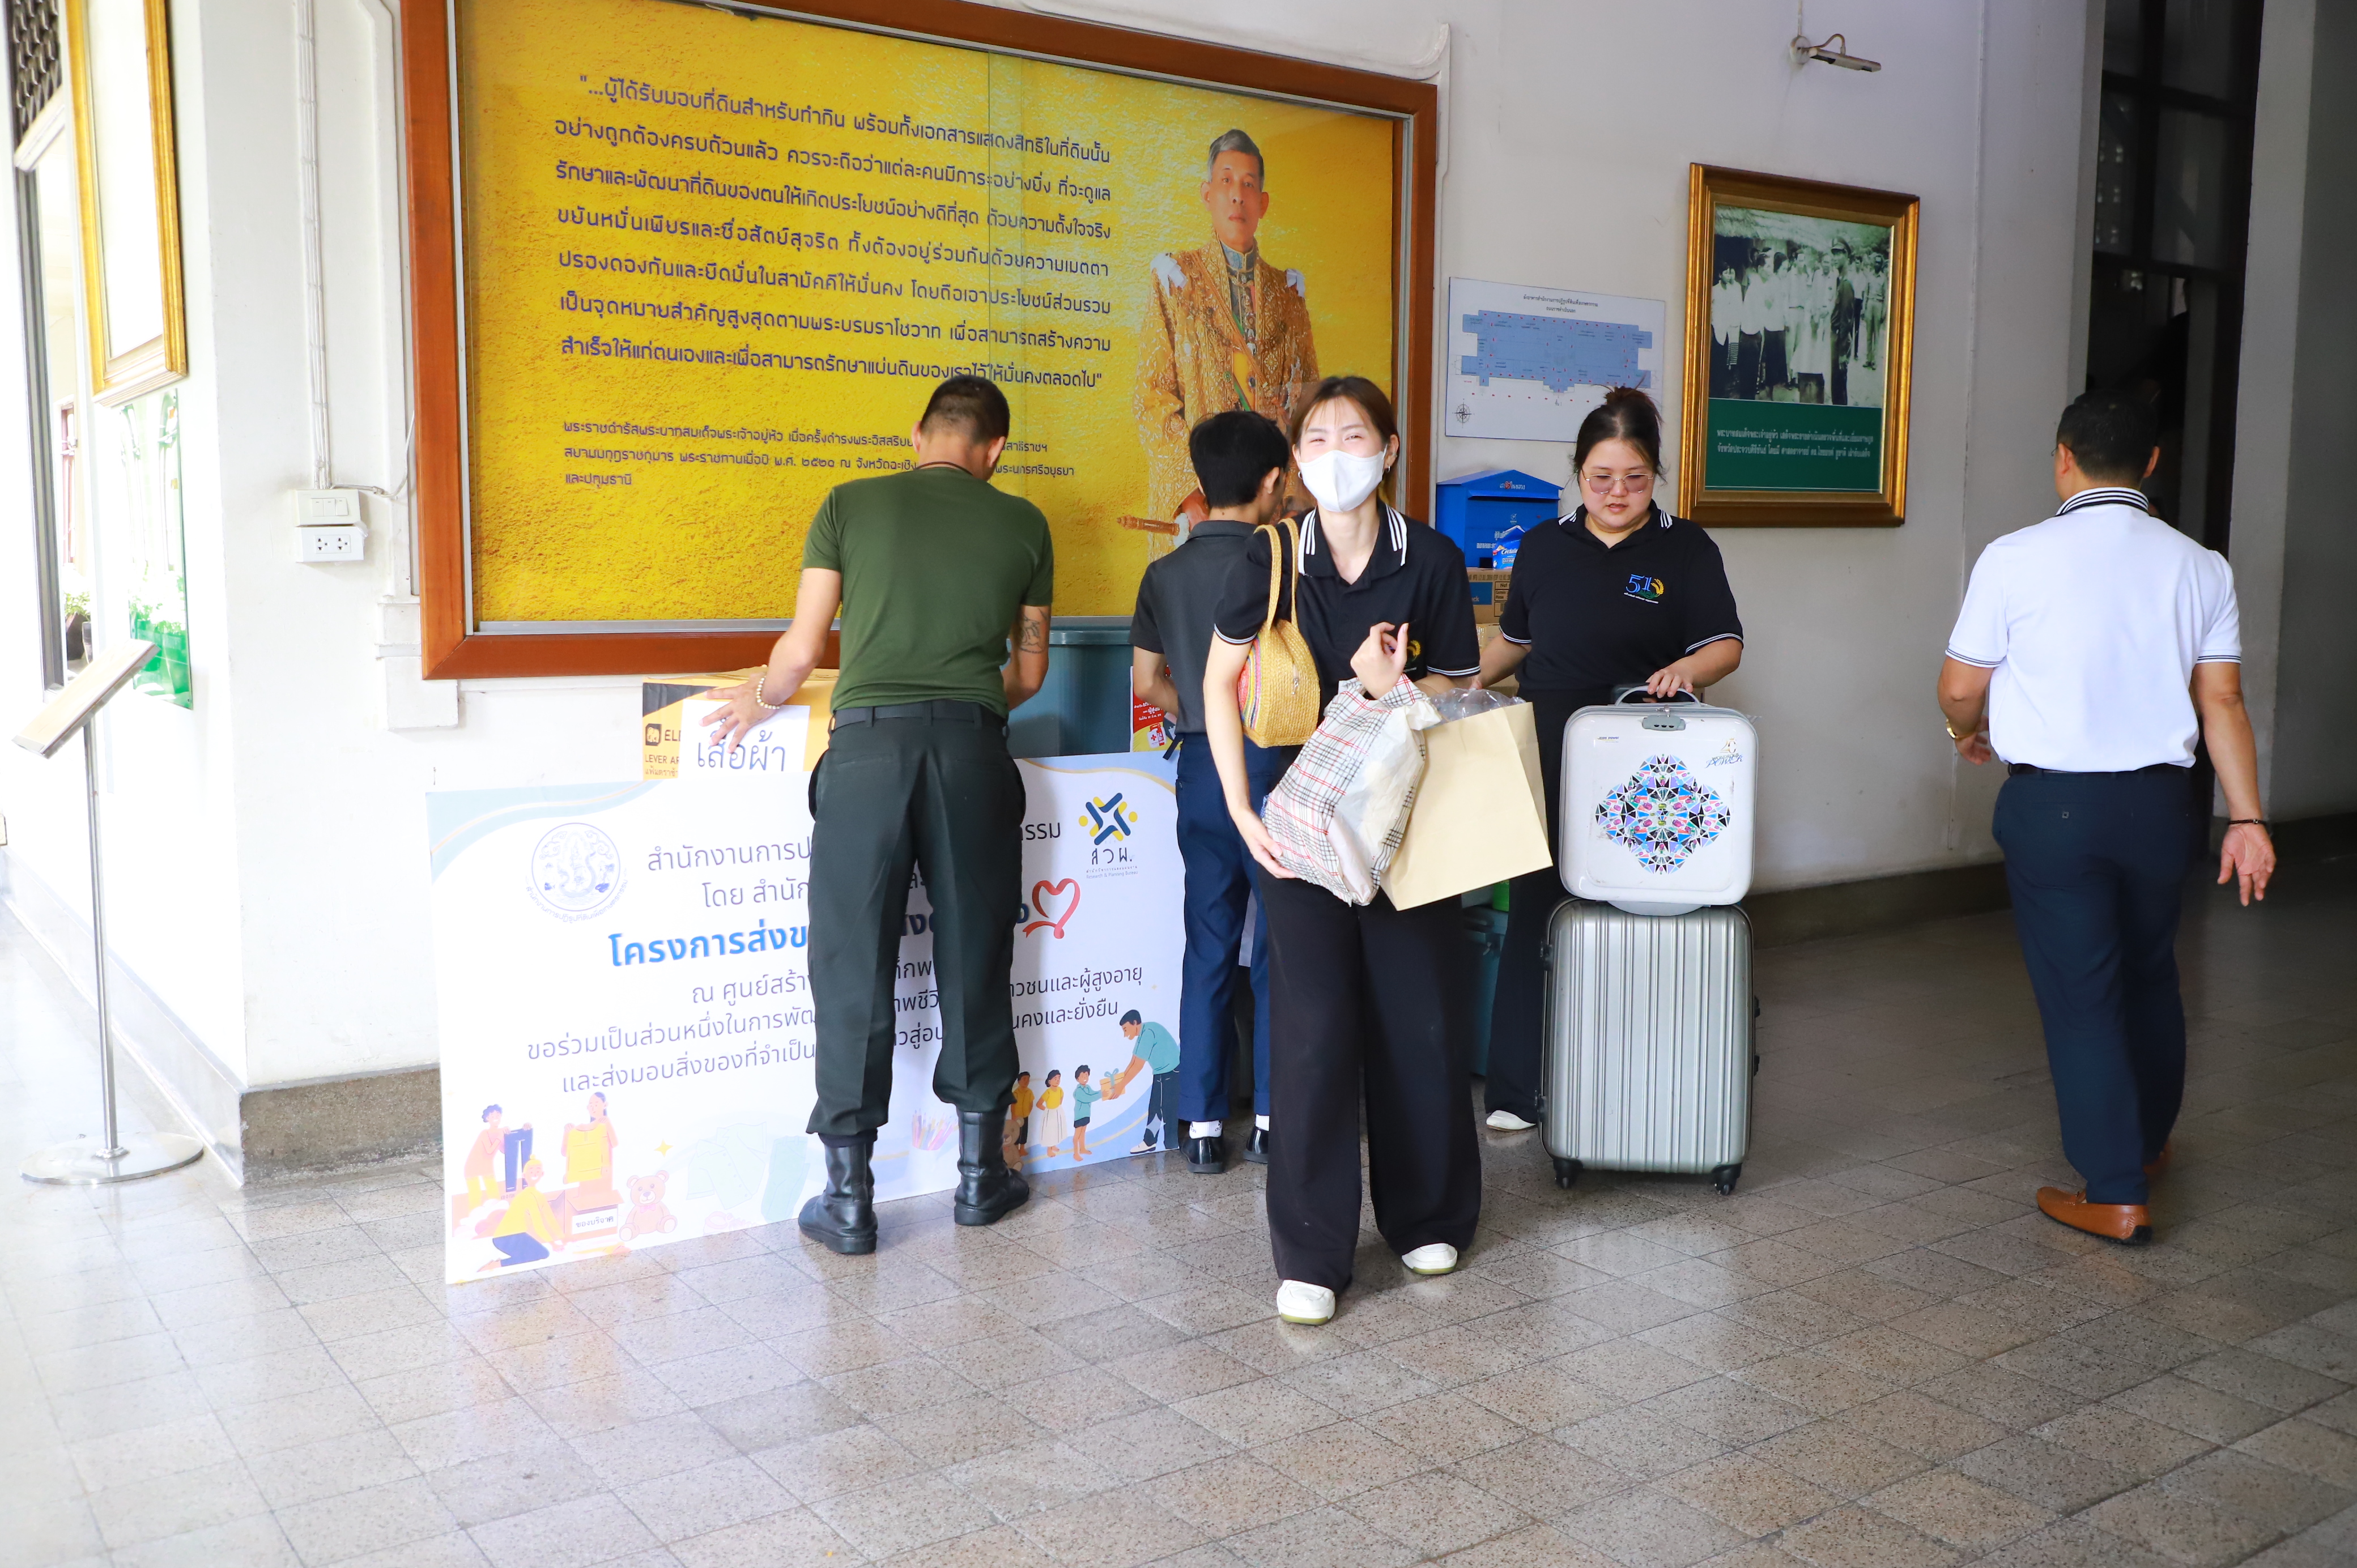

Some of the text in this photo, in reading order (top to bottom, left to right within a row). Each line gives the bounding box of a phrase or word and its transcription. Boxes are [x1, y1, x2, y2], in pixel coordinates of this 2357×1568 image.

[854, 113, 1110, 163] พร้อมทั้งเอกสารแสดงสิทธิในที่ดินนั้น
[555, 117, 1111, 204] อย่างถูกต้องครบถ้วนแล้ว ควรจะถือว่าแต่ละคนมีภาระอย่างยิ่ง ที่จะดูแล
[556, 160, 1111, 239] รักษาและพัฒนาที่ดินของตนให้เกิดประโยชน์อย่างดีที่สุด ด้วยความตั้งใจจริง
[558, 206, 1108, 276] ขยันหมั่นเพียรและซื่อสัตย์สุจริต ทั้งต้องอยู่ร่วมกันด้วยความเมตตา
[559, 251, 1111, 314] ปรองดองกันและยึดมั่นในสามัคคีให้มั่นคง โดยถือเอาประโยชน์ส่วนรวม
[561, 290, 1111, 352] เป็นจุดหมายสำคัญสูงสุดตามพระบรมราโชวาท เพื่อสามารถสร้างความ
[564, 421, 784, 444] พระราชดำรัสพระบาทสมเด็จพระเจ้าอยู่หัว
[788, 428, 913, 447] เมื่อครั้งดำรงพระอิสสริยย
[565, 472, 632, 488] และปทุมธานี
[679, 450, 769, 465] พระราชทานเมื่อปี
[775, 456, 796, 466] พ.ศ.
[840, 459, 851, 468] ณ
[856, 457, 917, 470] จังหวัดฉะเชิง
[1626, 574, 1652, 593] 51
[665, 729, 681, 742] EL
[645, 754, 667, 764] LEVER
[645, 765, 678, 777] แฟ้มตราช้า
[648, 823, 1061, 871] สำนักงานการป รรม
[701, 876, 809, 907] โดย สำนัก
[608, 918, 809, 966] โครงการส่งข
[692, 986, 714, 1004] ณ
[724, 969, 806, 1007] ศูนย์สร้า
[1010, 965, 1143, 998] าวชนและผู้สูงอายุ
[527, 1005, 815, 1060] ขอร่วมเป็นส่วนหนึ่งในการพัฒ
[1012, 997, 1119, 1030] นคงและยั่งยืน
[575, 1215, 615, 1229] ของบริจาค
